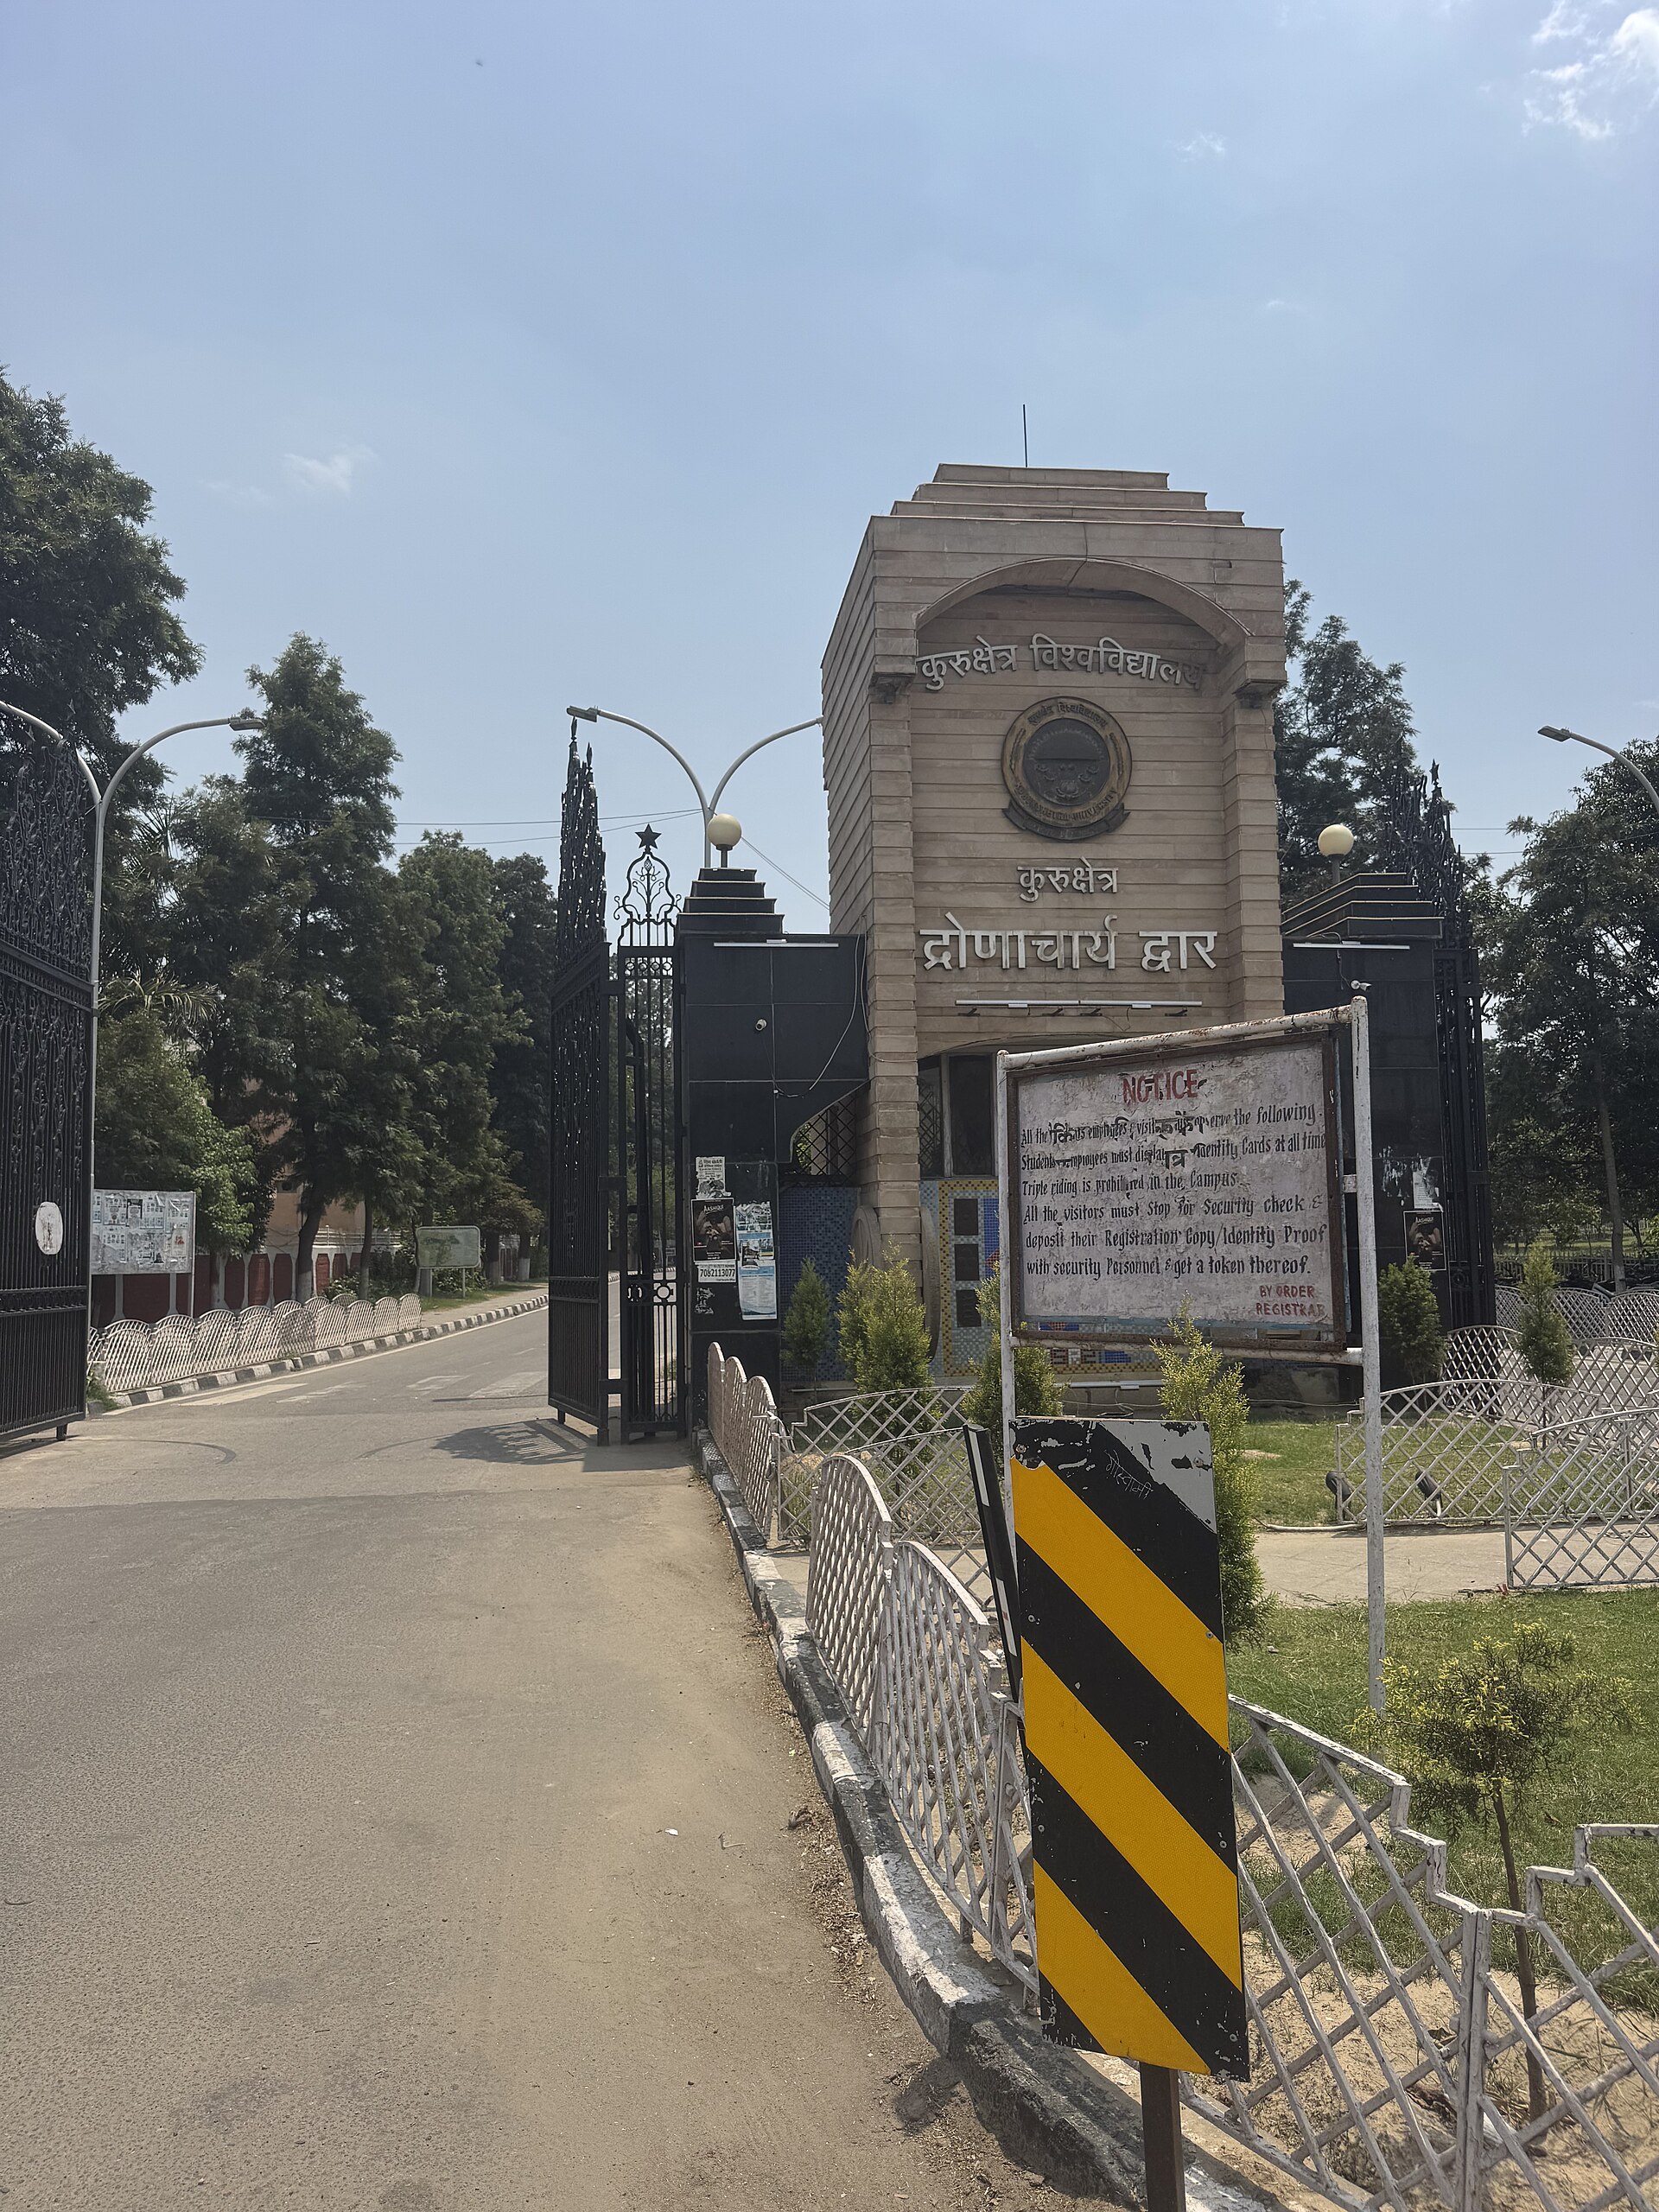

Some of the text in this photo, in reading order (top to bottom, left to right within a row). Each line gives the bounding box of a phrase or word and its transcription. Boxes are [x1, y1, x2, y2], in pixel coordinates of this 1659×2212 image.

[916, 634, 1018, 691] कुरुक्षेत्र
[1017, 855, 1119, 903] कुरुक्षेत्र
[919, 912, 1218, 973] द्रोणाचार्य द्वार
[1122, 1070, 1198, 1104] NOTICE
[1021, 1128, 1033, 1147] All
[1036, 1128, 1048, 1144] the
[1234, 1109, 1251, 1126] the
[1112, 1147, 1132, 1164] must
[1242, 1135, 1271, 1155] Cards
[1275, 1134, 1286, 1152] at
[1288, 1133, 1300, 1152] all
[1022, 1180, 1047, 1200] Triple
[1051, 1178, 1077, 1198] riding
[1083, 1177, 1090, 1192] is
[1149, 1173, 1160, 1190] in
[1165, 1173, 1183, 1189] the
[1023, 1205, 1038, 1224] All
[1043, 1205, 1058, 1221] the
[1065, 1205, 1105, 1221] visitors
[1111, 1202, 1140, 1218] must
[1147, 1201, 1171, 1219] Stop
[1264, 1194, 1305, 1212] check
[1312, 1194, 1324, 1209] &
[1071, 1231, 1096, 1247] their
[1105, 1228, 1179, 1251] Registration
[1284, 1224, 1327, 1243] Proof
[1027, 1259, 1050, 1275] with
[1053, 1257, 1101, 1281] security
[1107, 1256, 1160, 1275] Personnel
[1174, 1256, 1192, 1279] get
[1196, 1259, 1204, 1274] a
[1209, 1256, 1244, 1274] token
[1259, 1285, 1315, 1299] BY ORDER
[1255, 1302, 1325, 1318] REGISTRAR
